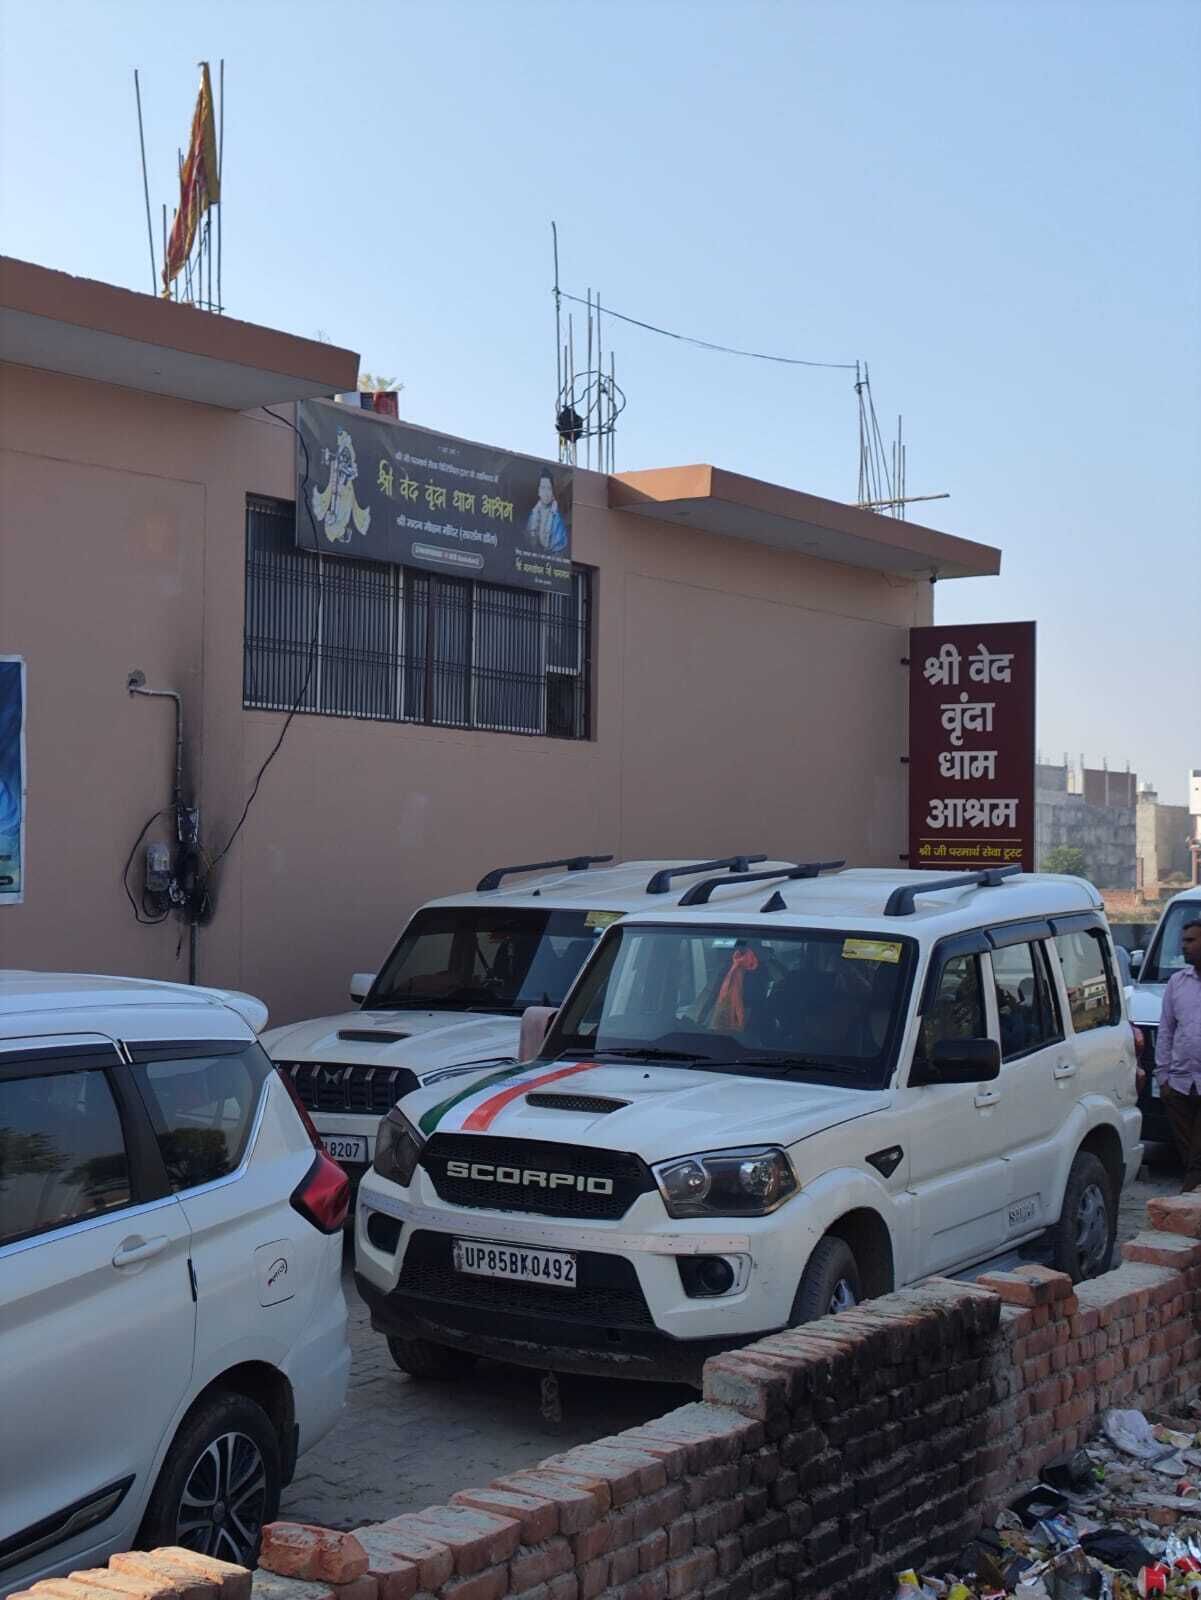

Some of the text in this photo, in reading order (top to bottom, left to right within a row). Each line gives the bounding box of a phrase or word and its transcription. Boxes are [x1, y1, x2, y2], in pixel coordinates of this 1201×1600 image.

[377, 459, 394, 496] श्री
[399, 474, 419, 502] वेद
[424, 479, 447, 511] वृंदा
[453, 490, 476, 514] धाम
[481, 494, 514, 523] आश्रम
[923, 643, 1015, 686] श्री वेद
[940, 692, 996, 746] वृंदा
[938, 750, 998, 780] धाम
[926, 798, 1019, 829] आश्रम
[919, 844, 931, 857] श्री
[934, 844, 946, 857] जी
[983, 845, 1001, 857] सेवा
[447, 1161, 613, 1195] SCORPIO
[465, 1247, 575, 1282] UP85BK0492
